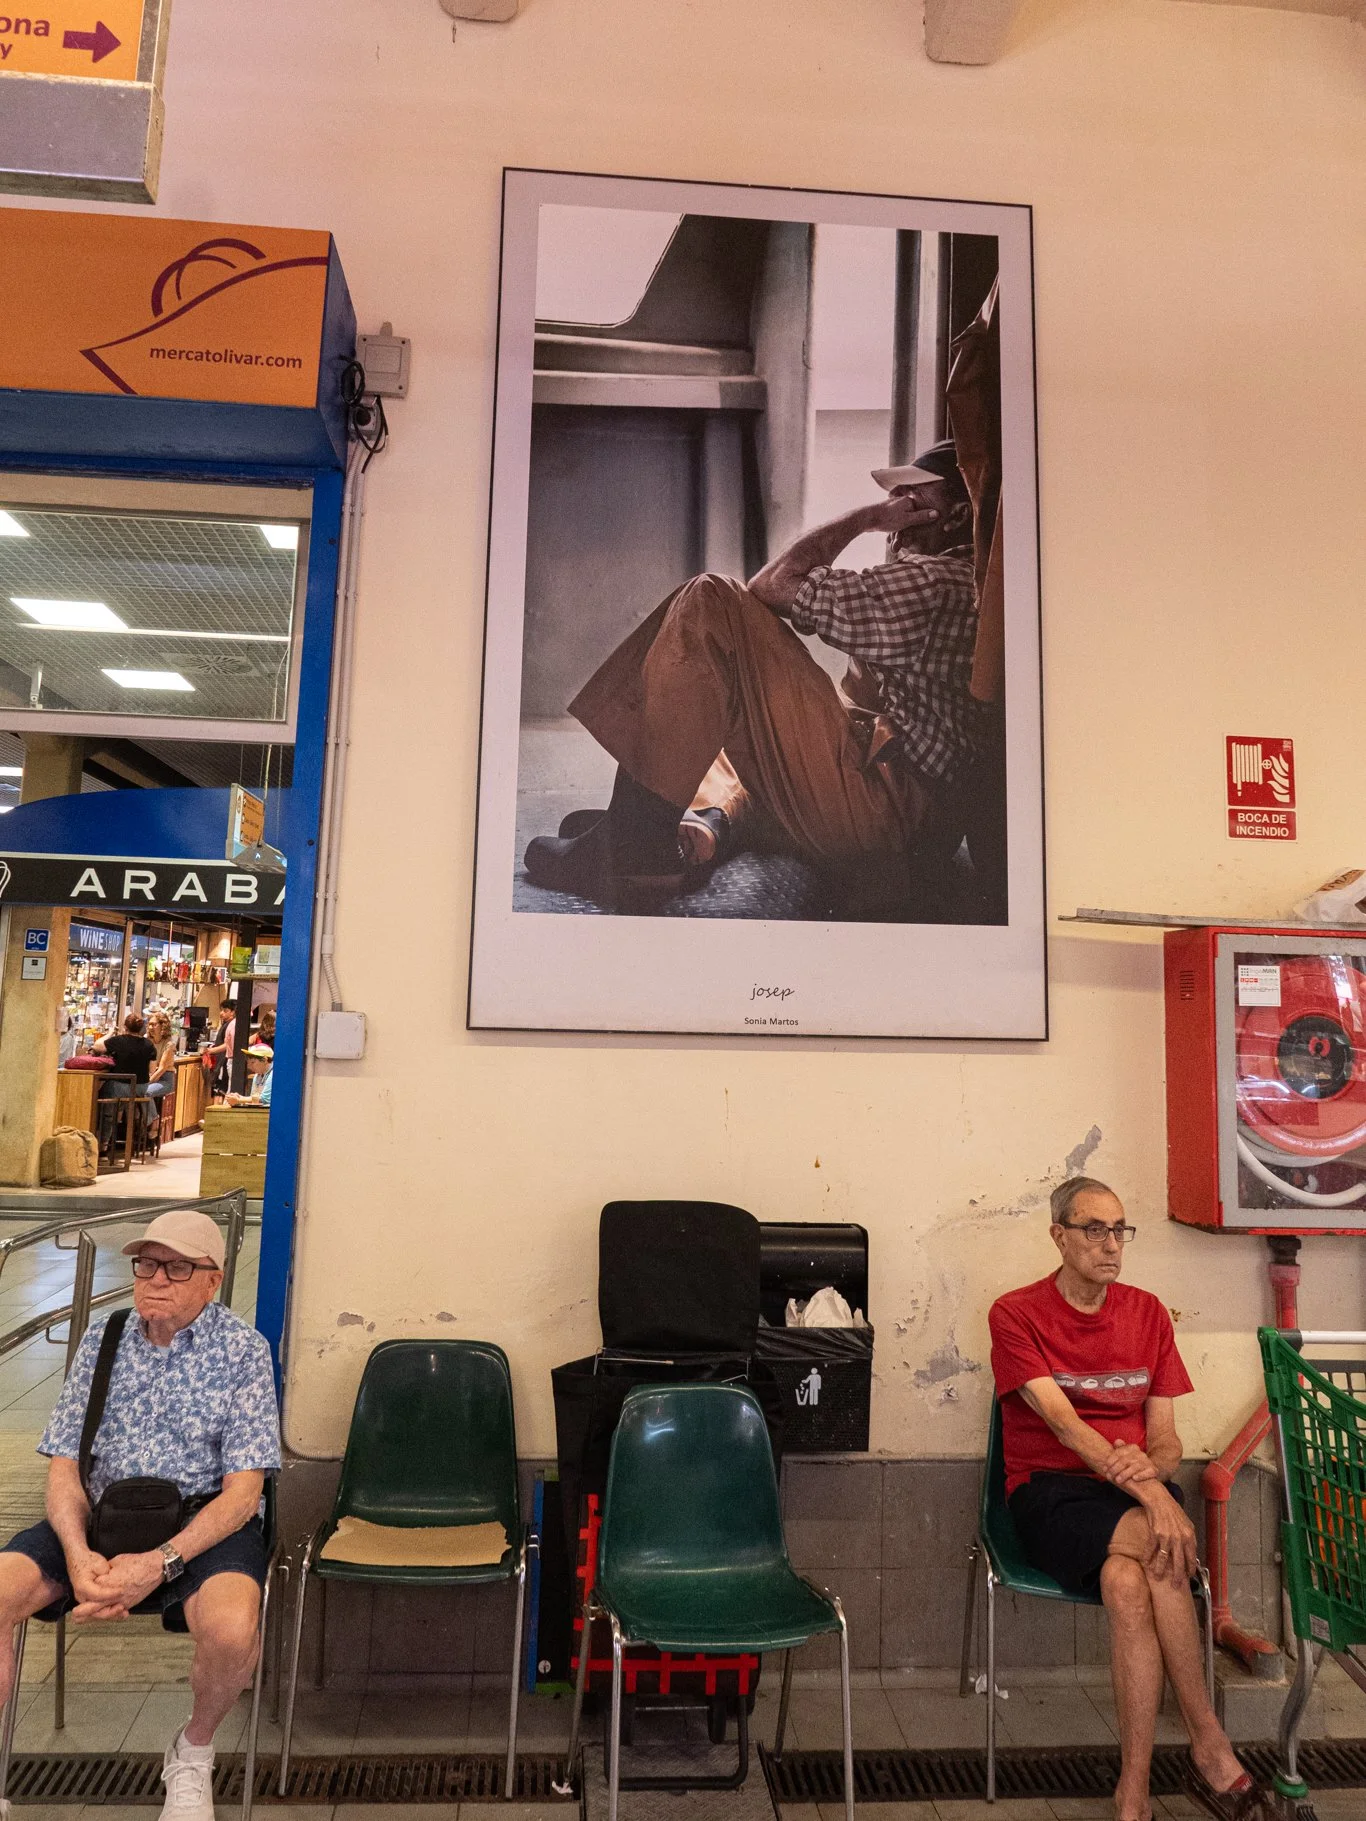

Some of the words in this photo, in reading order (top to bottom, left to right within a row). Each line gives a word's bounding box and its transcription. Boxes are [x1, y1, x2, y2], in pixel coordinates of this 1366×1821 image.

[149, 347, 303, 369] mercatolivar.com
[1237, 812, 1270, 824] BOCA
[1271, 814, 1287, 824] DE
[1236, 825, 1289, 837] INCENDIO
[69, 867, 286, 905] ARAB
[27, 932, 47, 945] BC
[749, 983, 796, 1002] josep
[744, 1017, 767, 1025] Sonia
[769, 1017, 799, 1026] Martos
